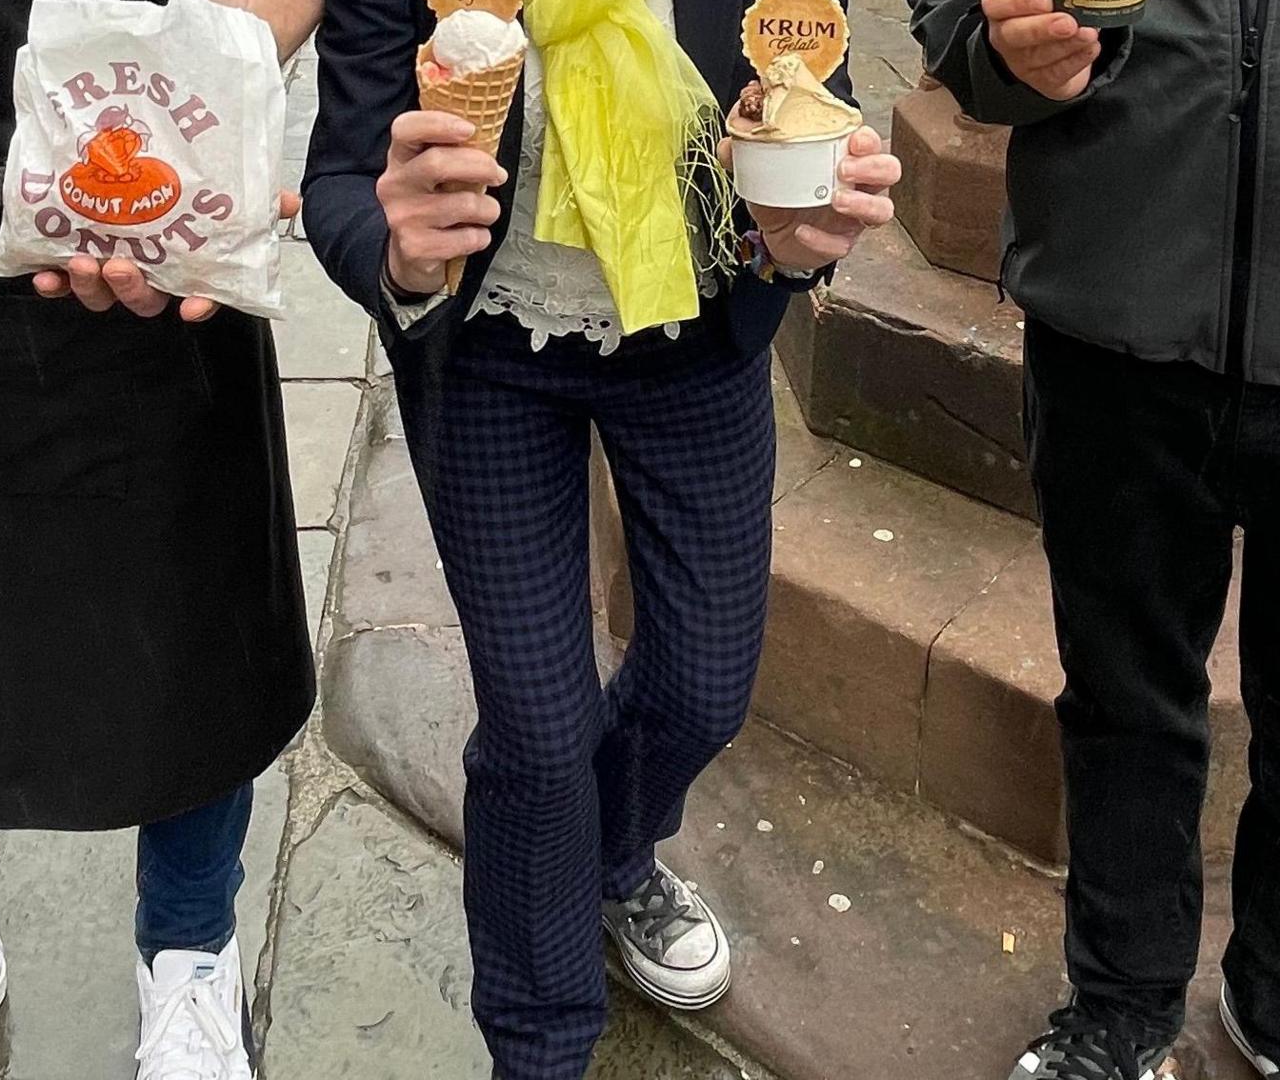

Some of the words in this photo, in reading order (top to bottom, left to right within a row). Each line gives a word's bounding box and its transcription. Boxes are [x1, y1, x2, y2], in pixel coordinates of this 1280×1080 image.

[759, 18, 835, 39] KRUM
[768, 36, 820, 56] Gelato
[130, 182, 174, 215] MAN
[20, 167, 234, 265] DONUTS
